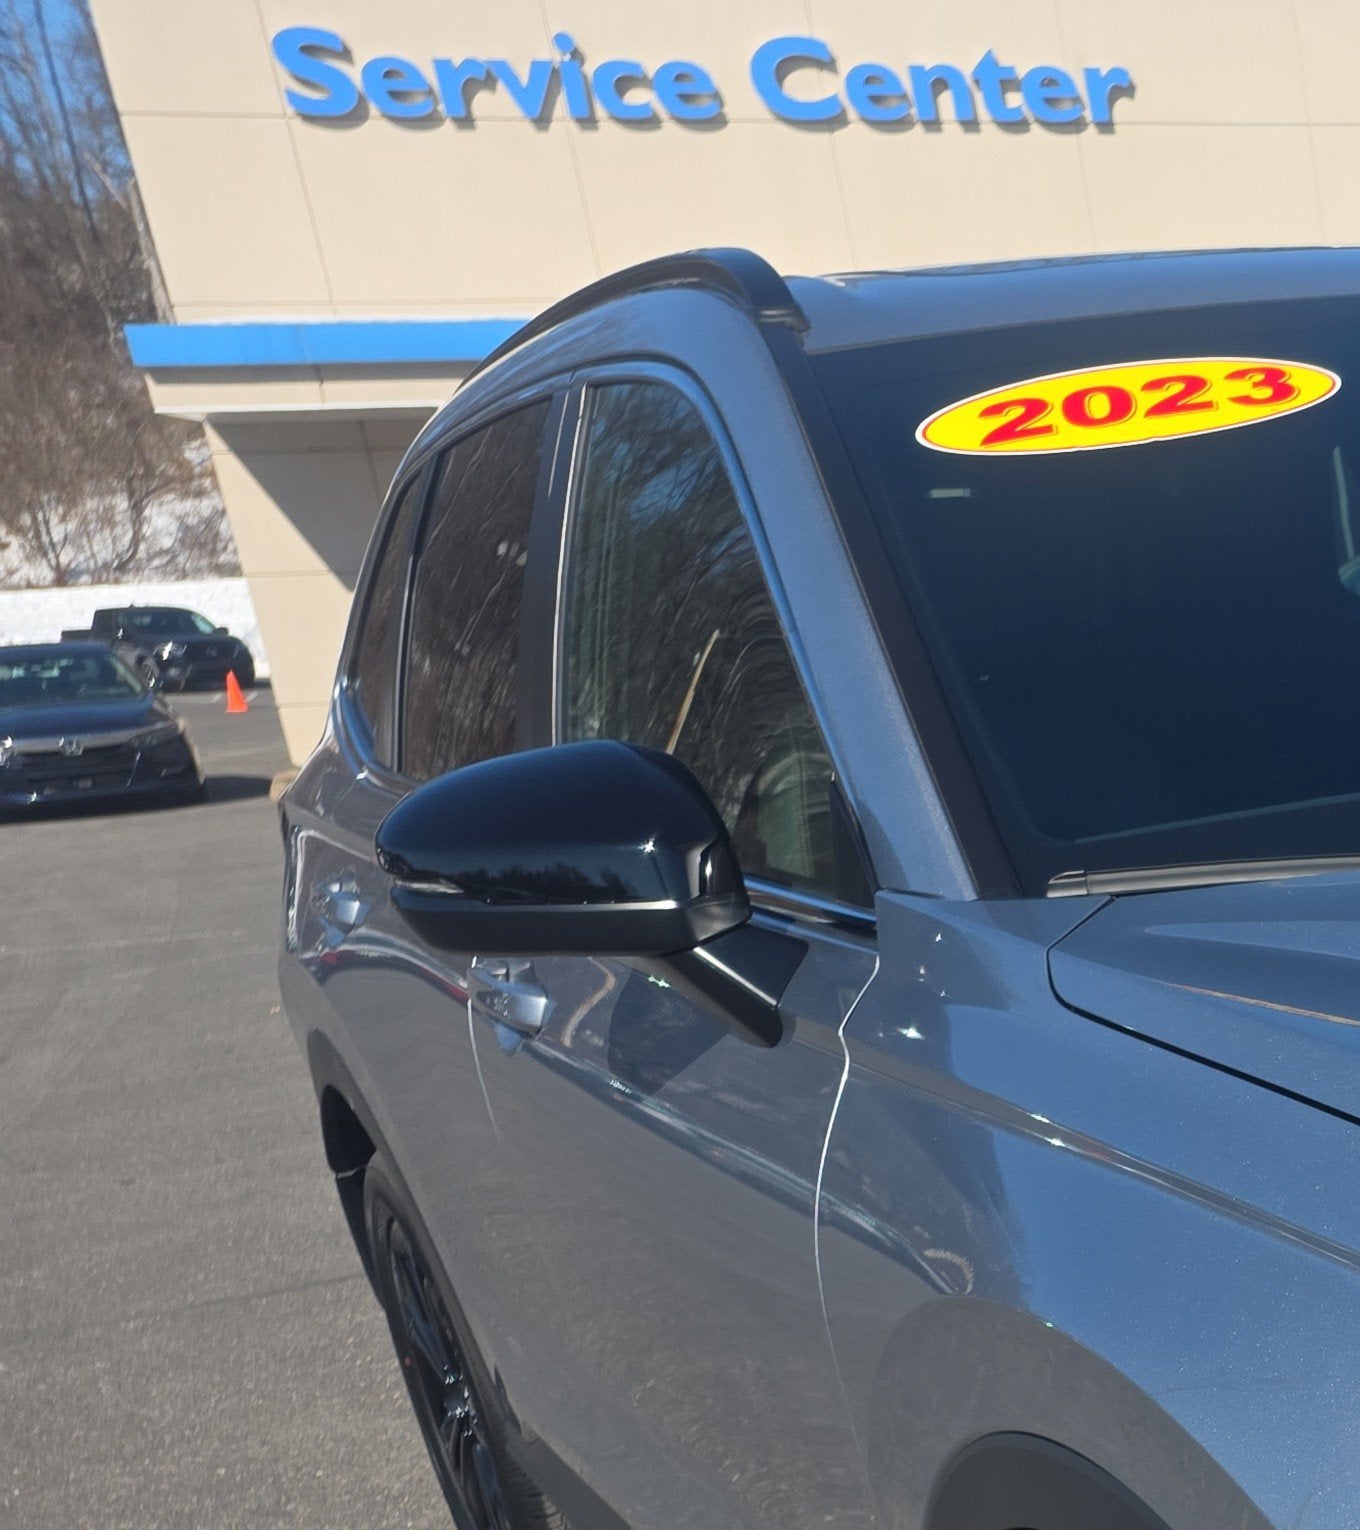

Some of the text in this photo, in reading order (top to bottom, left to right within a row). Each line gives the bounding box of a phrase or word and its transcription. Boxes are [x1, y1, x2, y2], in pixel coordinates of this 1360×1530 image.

[272, 27, 1133, 124] Service Center
[979, 366, 1300, 447] 2023
